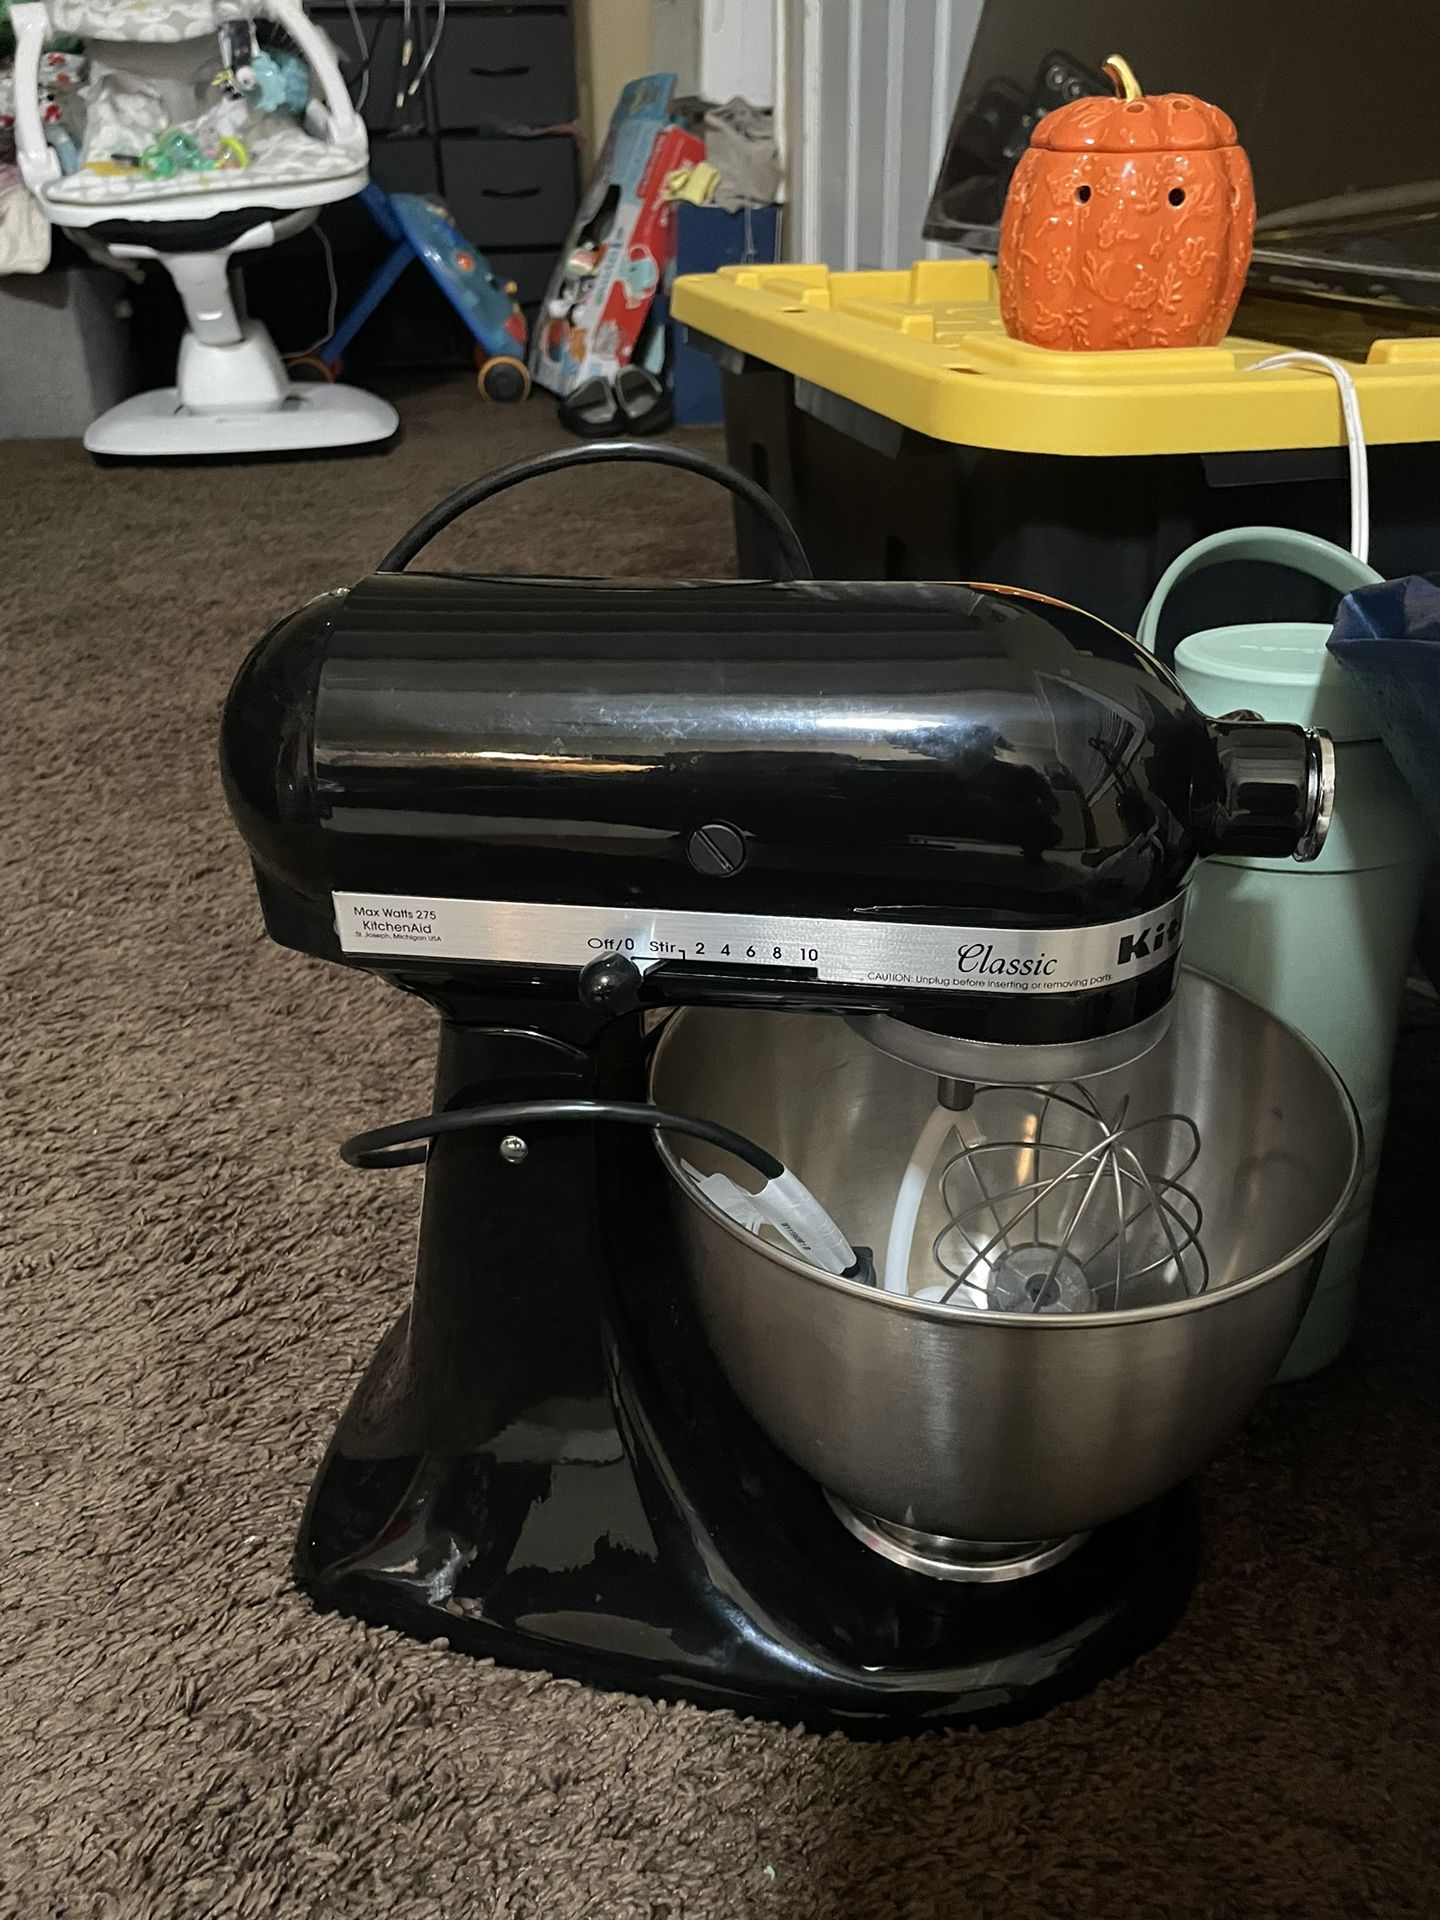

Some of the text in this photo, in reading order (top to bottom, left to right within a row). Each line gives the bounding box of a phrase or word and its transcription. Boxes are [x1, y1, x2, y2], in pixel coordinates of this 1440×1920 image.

[354, 906, 437, 920] Max Watts 275
[363, 920, 432, 934] KitchenAid
[393, 933, 426, 941] Michigan
[1117, 918, 1181, 965] Kit
[649, 940, 676, 953] Stir
[695, 942, 705, 955] 2
[720, 944, 731, 956] 4
[746, 945, 756, 958] 6
[772, 946, 782, 959] 8
[801, 948, 818, 961] 10
[957, 943, 1057, 976] Classic
[867, 972, 913, 983] CAUTION:
[916, 975, 950, 986] Unplug
[953, 977, 985, 987] before
[988, 979, 1028, 990] inserting
[1031, 981, 1041, 989] or
[1043, 978, 1088, 989] removing
